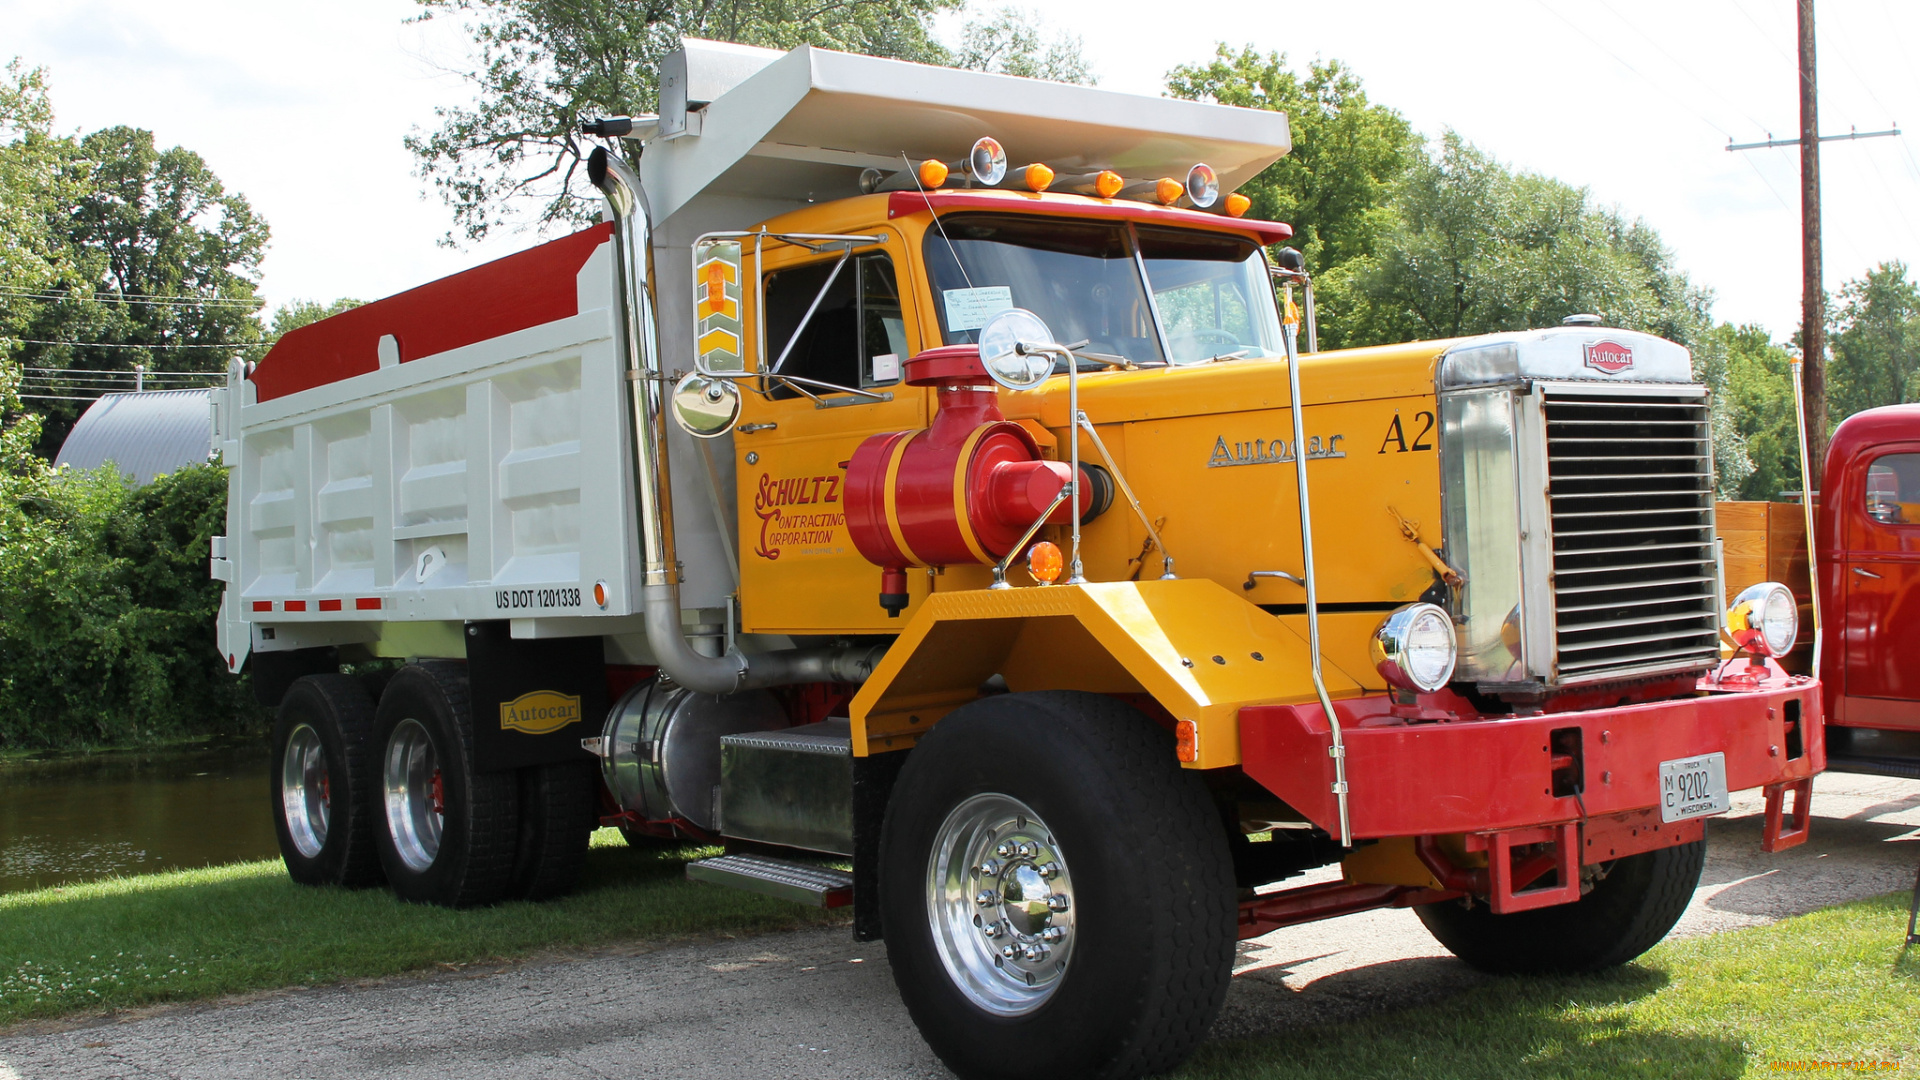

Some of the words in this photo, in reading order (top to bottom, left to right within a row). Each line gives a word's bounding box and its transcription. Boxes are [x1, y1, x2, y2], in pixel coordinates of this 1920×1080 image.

[1590, 348, 1632, 364] Autocar
[1378, 411, 1435, 454] A2
[755, 473, 840, 510] SCHULTZ
[495, 590, 510, 609] US
[512, 589, 535, 609] DOT
[537, 588, 581, 608] 1201338
[507, 703, 576, 723] Autocar
[1678, 770, 1710, 802] 9202
[1681, 802, 1713, 815] WISCONSIN
